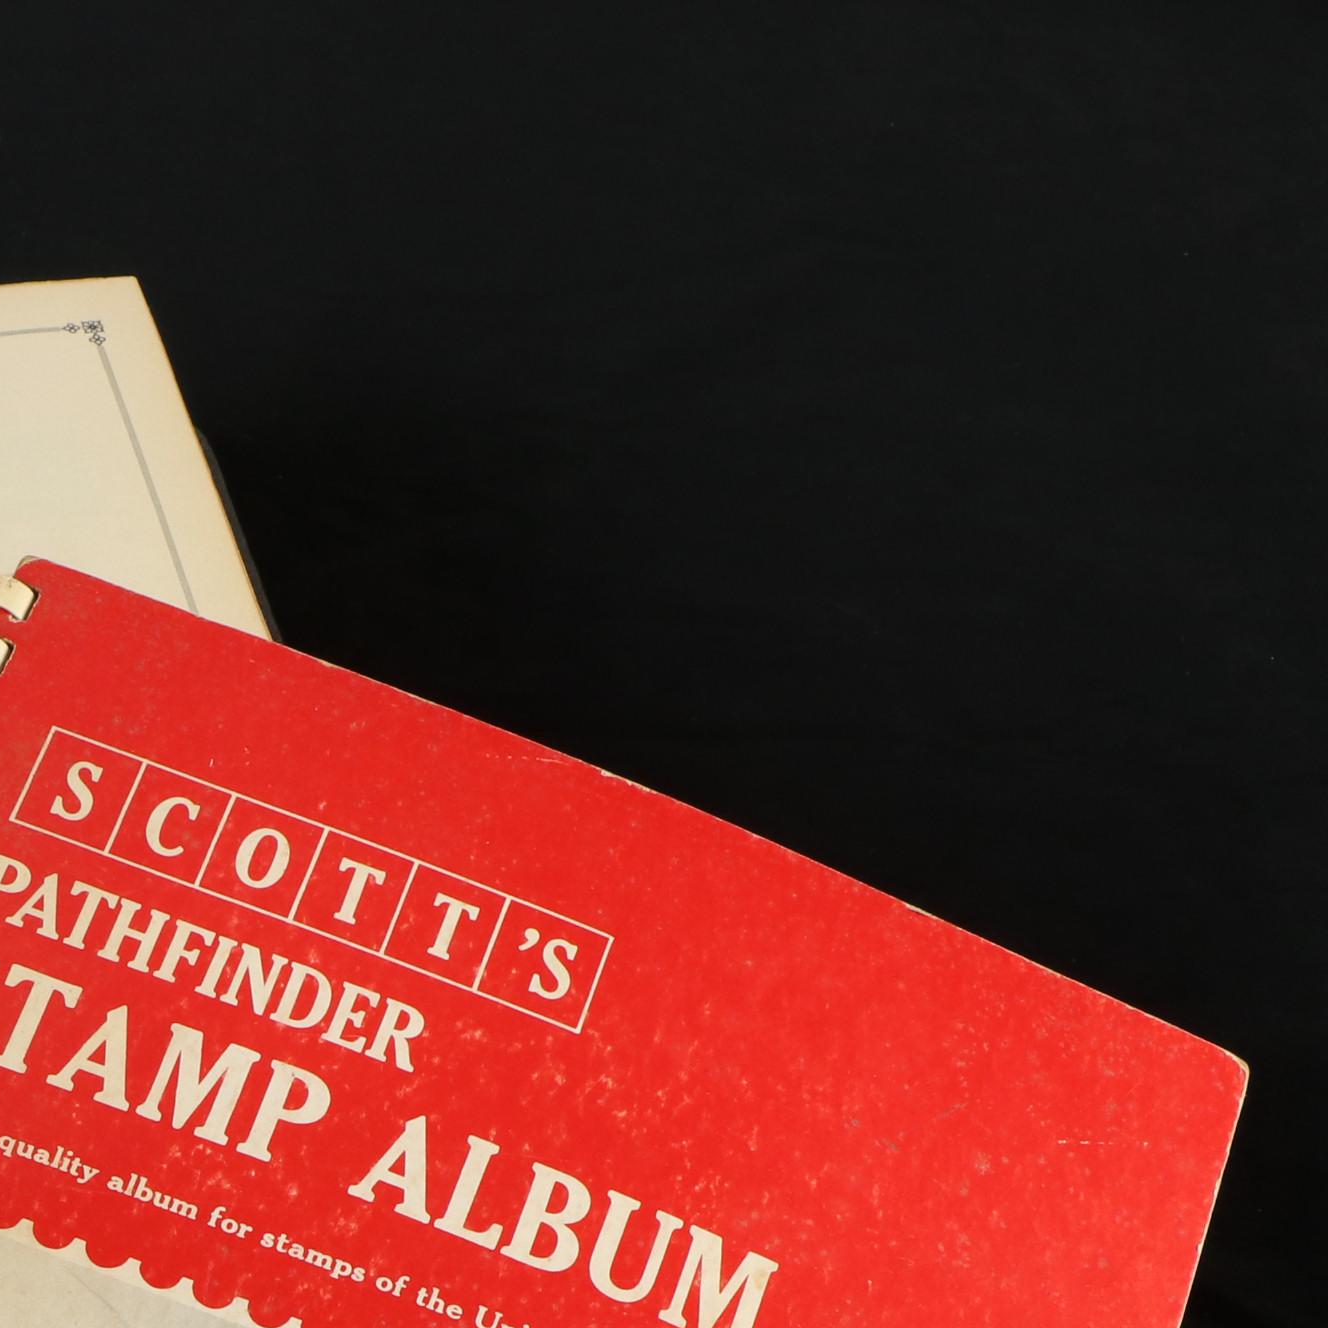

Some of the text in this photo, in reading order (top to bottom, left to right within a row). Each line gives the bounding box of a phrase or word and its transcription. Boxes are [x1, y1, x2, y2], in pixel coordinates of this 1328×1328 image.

[107, 1172, 200, 1221] album
[207, 1206, 254, 1241] for
[259, 1230, 367, 1284] stamps
[375, 1273, 411, 1298] of
[415, 1286, 464, 1321] the
